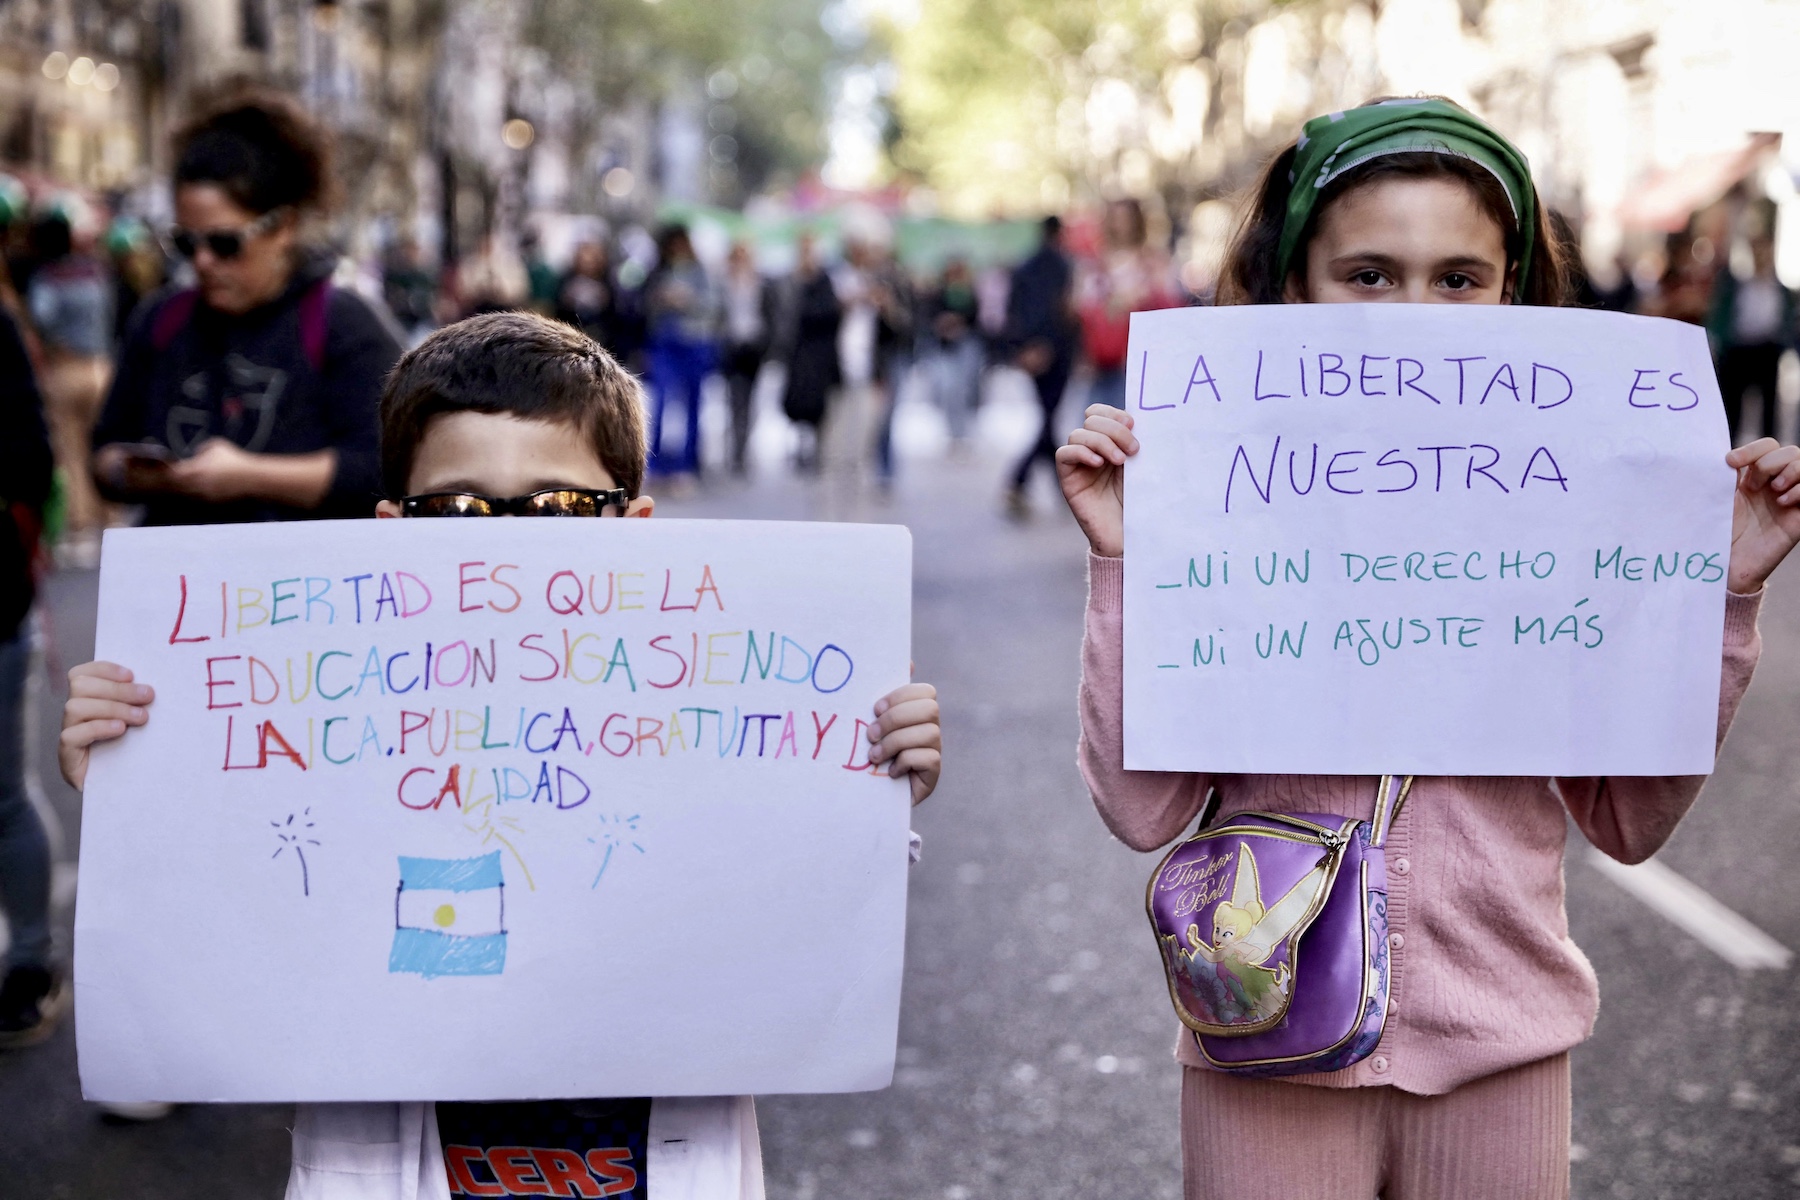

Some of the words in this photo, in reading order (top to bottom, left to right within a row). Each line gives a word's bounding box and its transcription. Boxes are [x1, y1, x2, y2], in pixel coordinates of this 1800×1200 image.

[1138, 350, 1222, 412] LA
[1627, 368, 1701, 412] ES
[1224, 434, 1569, 514] NUESTRA
[1254, 548, 1310, 587] UN
[1339, 550, 1557, 584] DERECHO
[1594, 545, 1726, 583] MENOS
[167, 570, 433, 646] LIBERTAD
[458, 560, 523, 614] ES
[545, 569, 645, 617] QUE
[659, 563, 725, 613] LA
[1254, 618, 1309, 660] UN
[1333, 614, 1485, 667] AJUSTE
[1513, 597, 1604, 650] MÁS
[204, 638, 498, 711] EDUCACION
[517, 627, 637, 693] SIGA
[646, 629, 854, 695] SIENDO
[810, 709, 839, 761] Y
[396, 760, 592, 816] CALIDAD
[1159, 851, 1234, 891] Tinker
[1173, 872, 1231, 917] Bell
[445, 1143, 637, 1199] CERS
